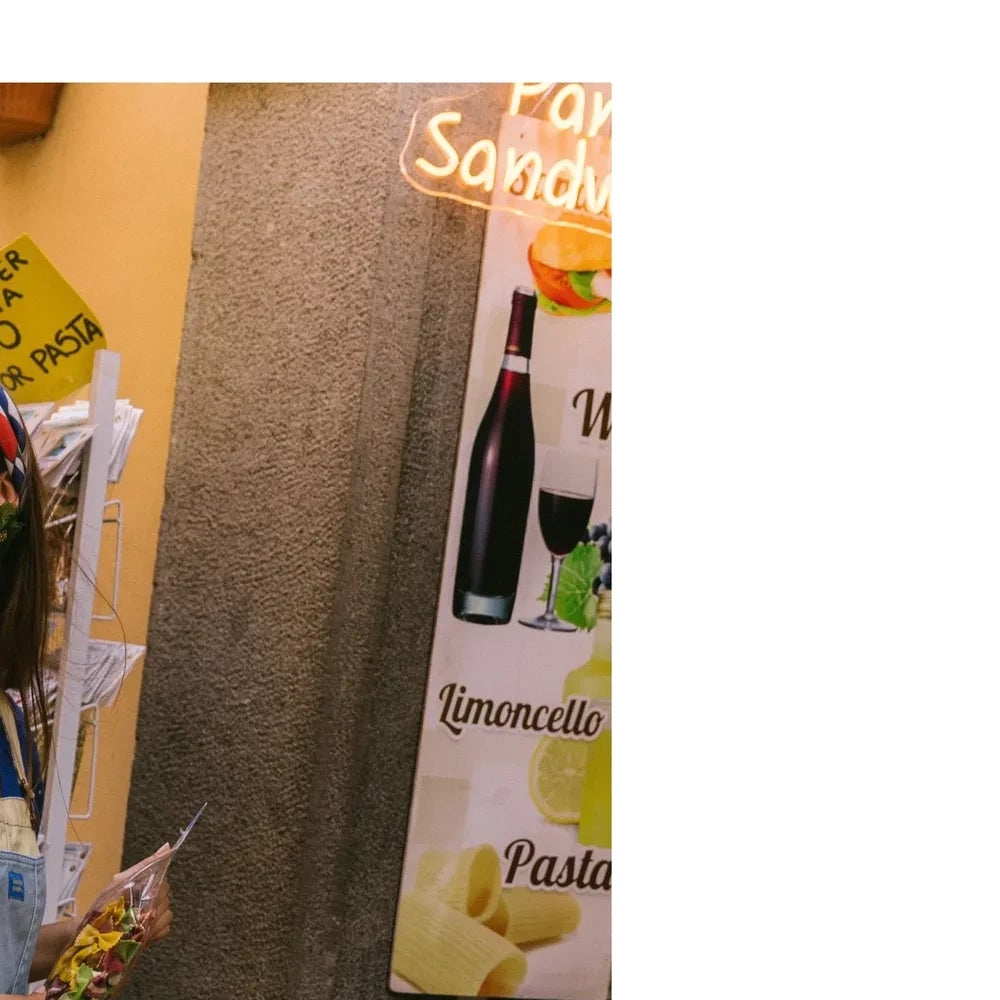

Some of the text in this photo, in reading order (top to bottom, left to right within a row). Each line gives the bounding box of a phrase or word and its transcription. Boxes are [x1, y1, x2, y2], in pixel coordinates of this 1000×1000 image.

[30, 313, 103, 373] PASTA
[439, 683, 604, 736] Limoncello
[504, 838, 611, 891] Pasta
